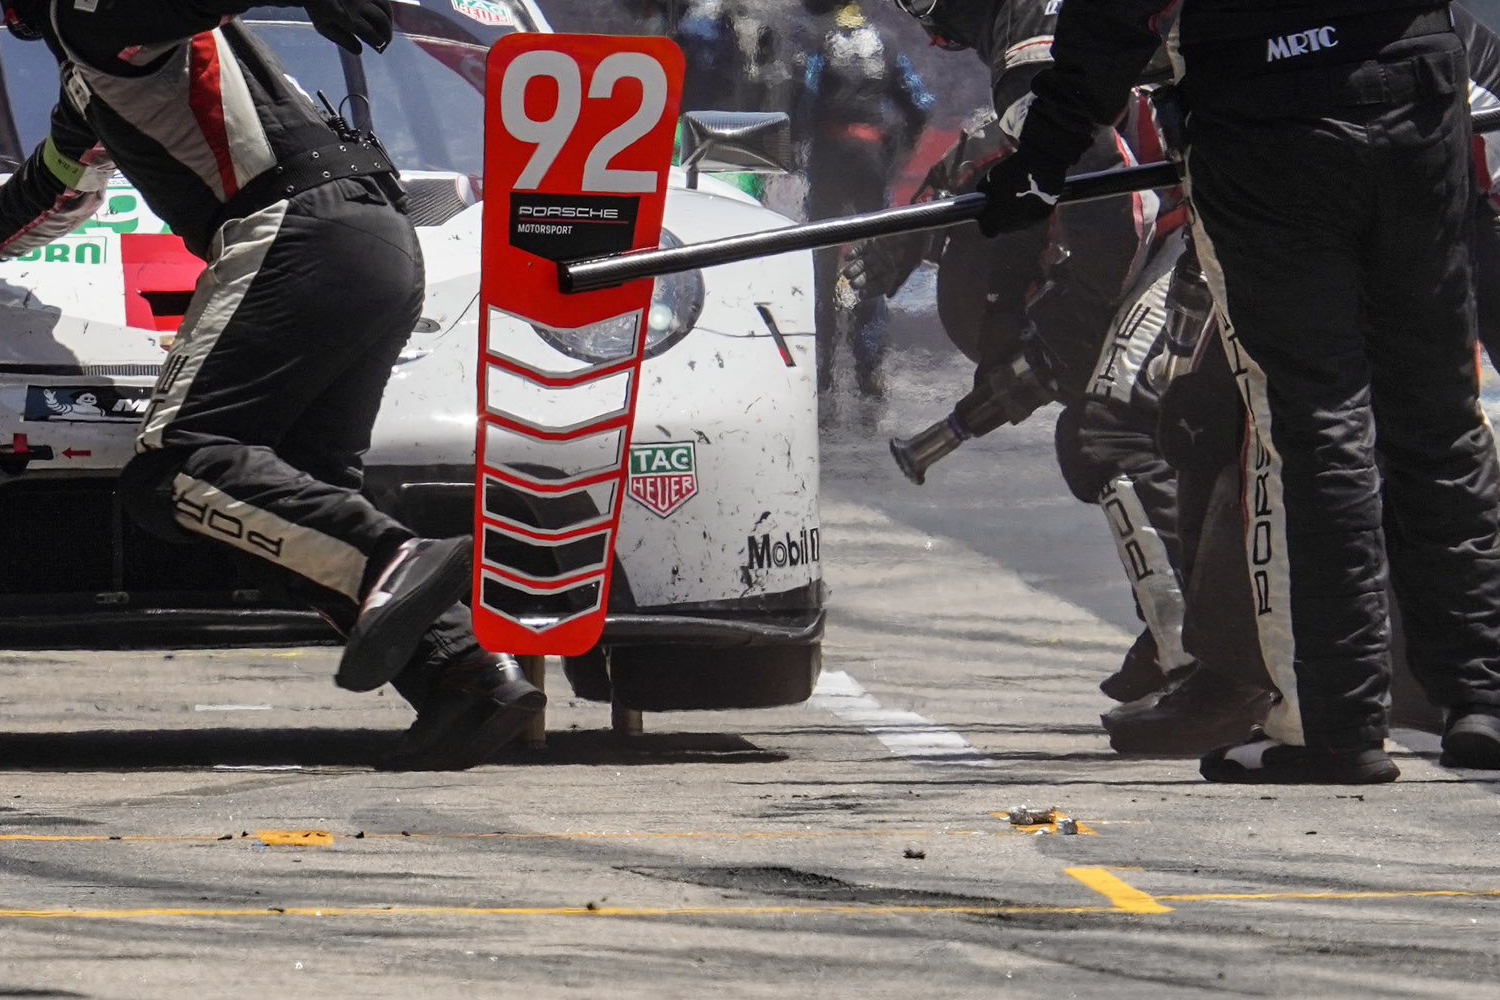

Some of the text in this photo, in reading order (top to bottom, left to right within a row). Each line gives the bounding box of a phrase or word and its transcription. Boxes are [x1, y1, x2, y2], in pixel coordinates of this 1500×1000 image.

[1266, 26, 1338, 62] MRTC
[500, 49, 668, 193] 92
[518, 205, 619, 219] PORSCHE
[517, 223, 573, 236] MOTORSPORT
[633, 448, 691, 473] TAG
[631, 477, 695, 509] HEUER
[747, 530, 808, 571] Mobil
